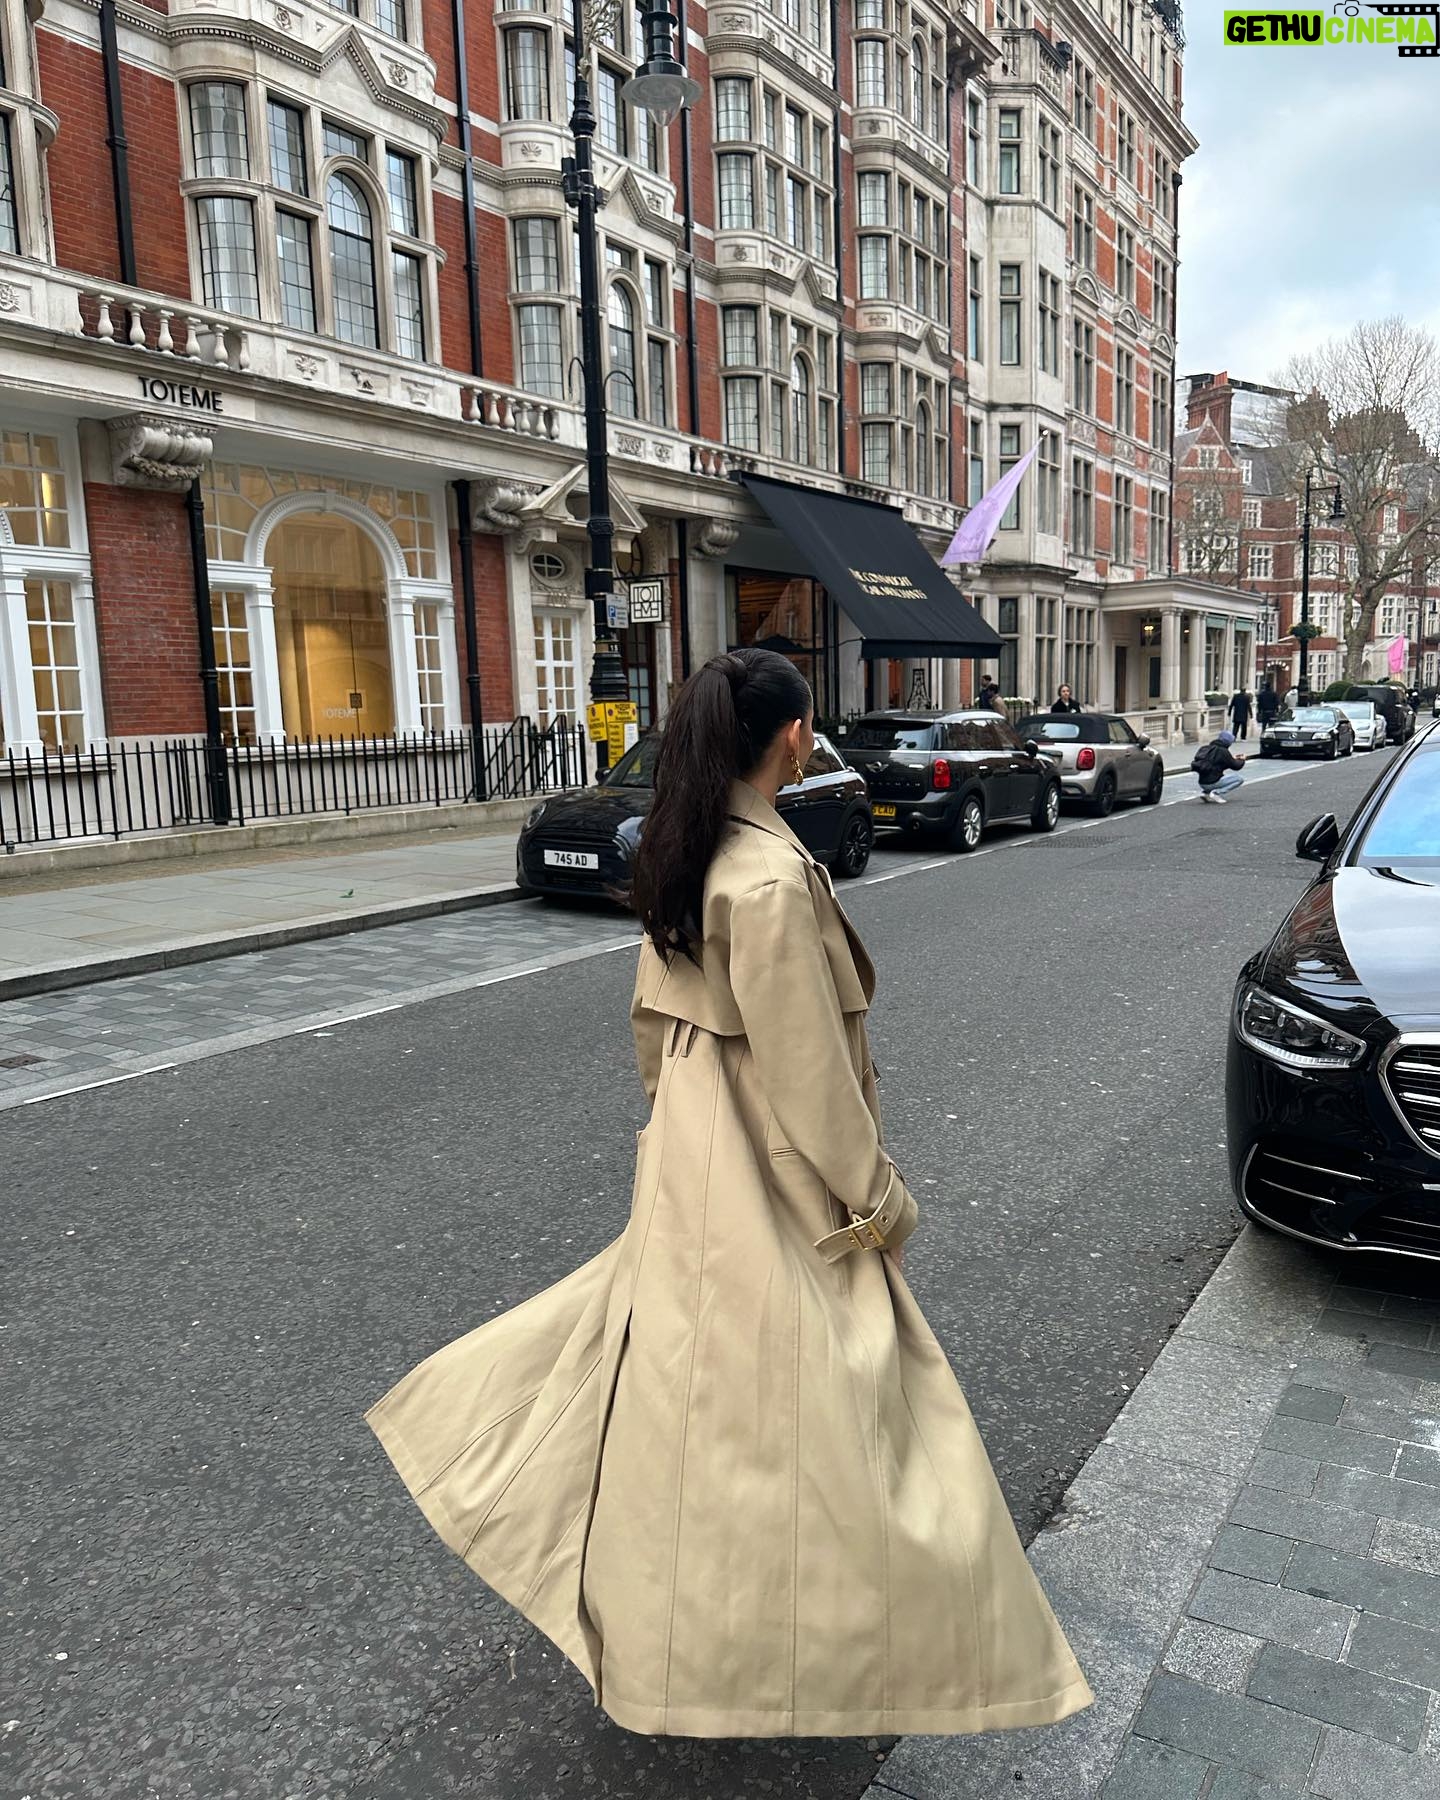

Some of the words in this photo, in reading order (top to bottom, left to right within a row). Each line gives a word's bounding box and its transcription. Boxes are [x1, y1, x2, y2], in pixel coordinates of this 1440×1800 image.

[138, 376, 223, 412] TOTEME
[554, 852, 572, 864] 745
[575, 854, 587, 866] AD
